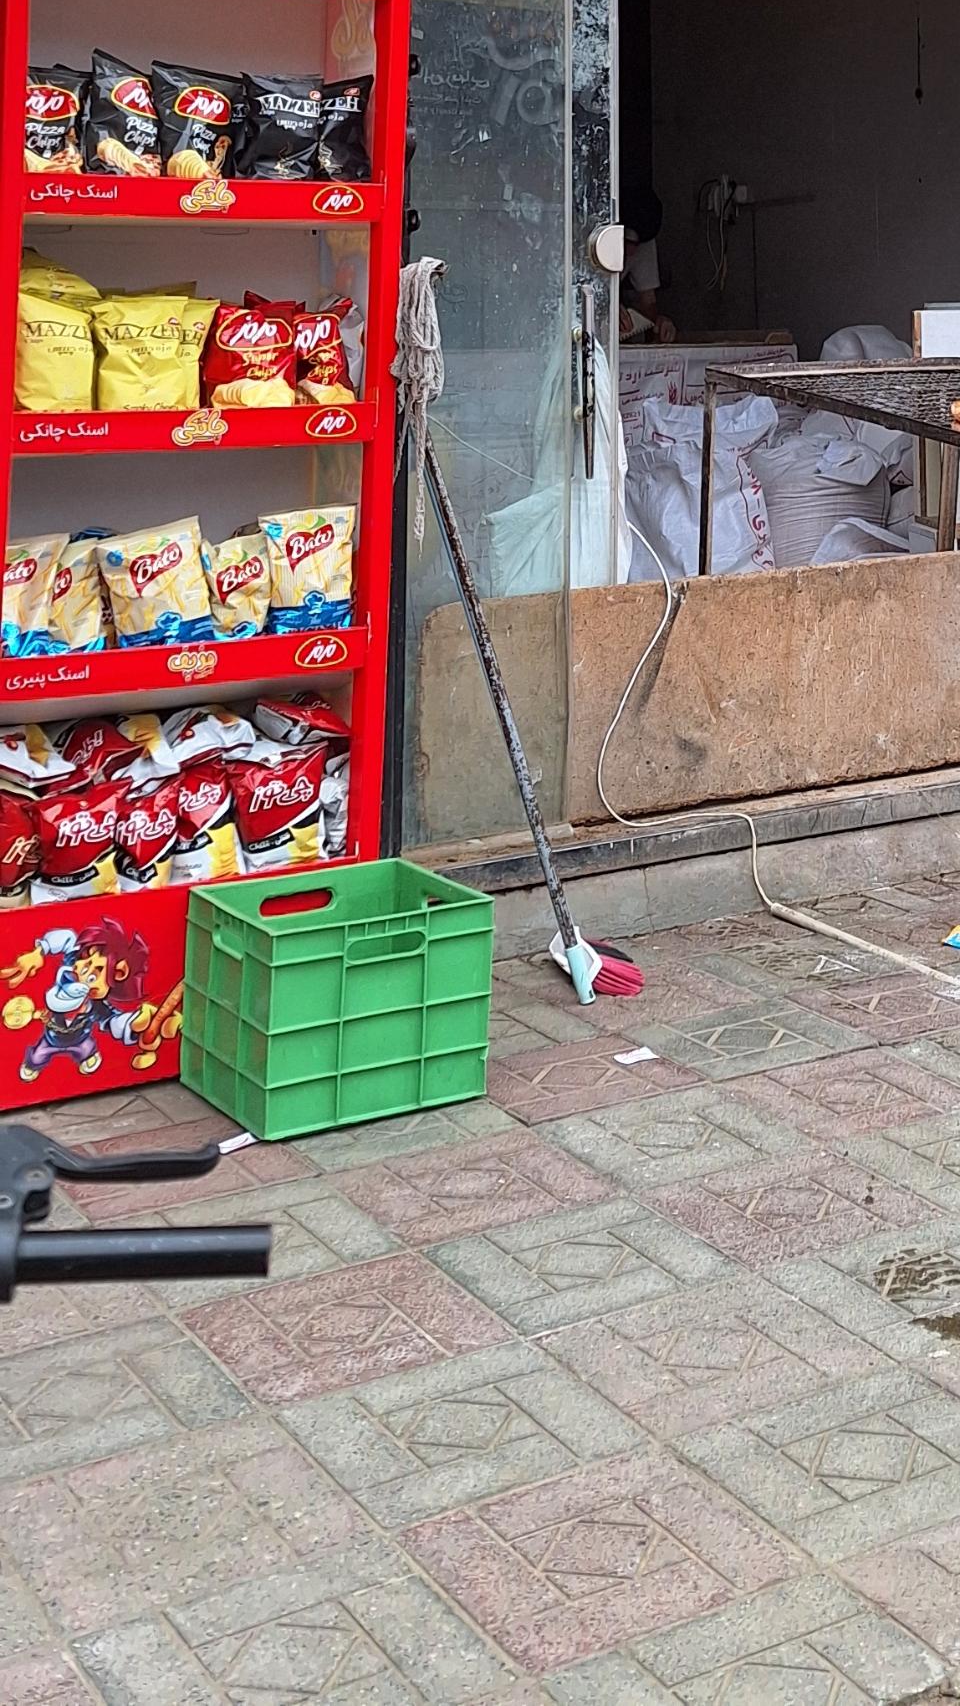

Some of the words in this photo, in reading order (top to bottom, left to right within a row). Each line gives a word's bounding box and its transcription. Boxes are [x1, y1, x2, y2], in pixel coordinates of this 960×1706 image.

[26, 136, 60, 149] Chips
[124, 130, 156, 147] Chips
[30, 182, 75, 203] چانکی
[77, 184, 118, 199] اسنک
[19, 422, 66, 443] چانکی
[67, 421, 109, 437] اسنک
[290, 530, 333, 560] Bato
[3, 562, 34, 582] ato
[133, 546, 179, 583] Bato
[221, 561, 262, 592] Bato
[5, 670, 47, 691] پنیری
[48, 664, 91, 682] اسنک
